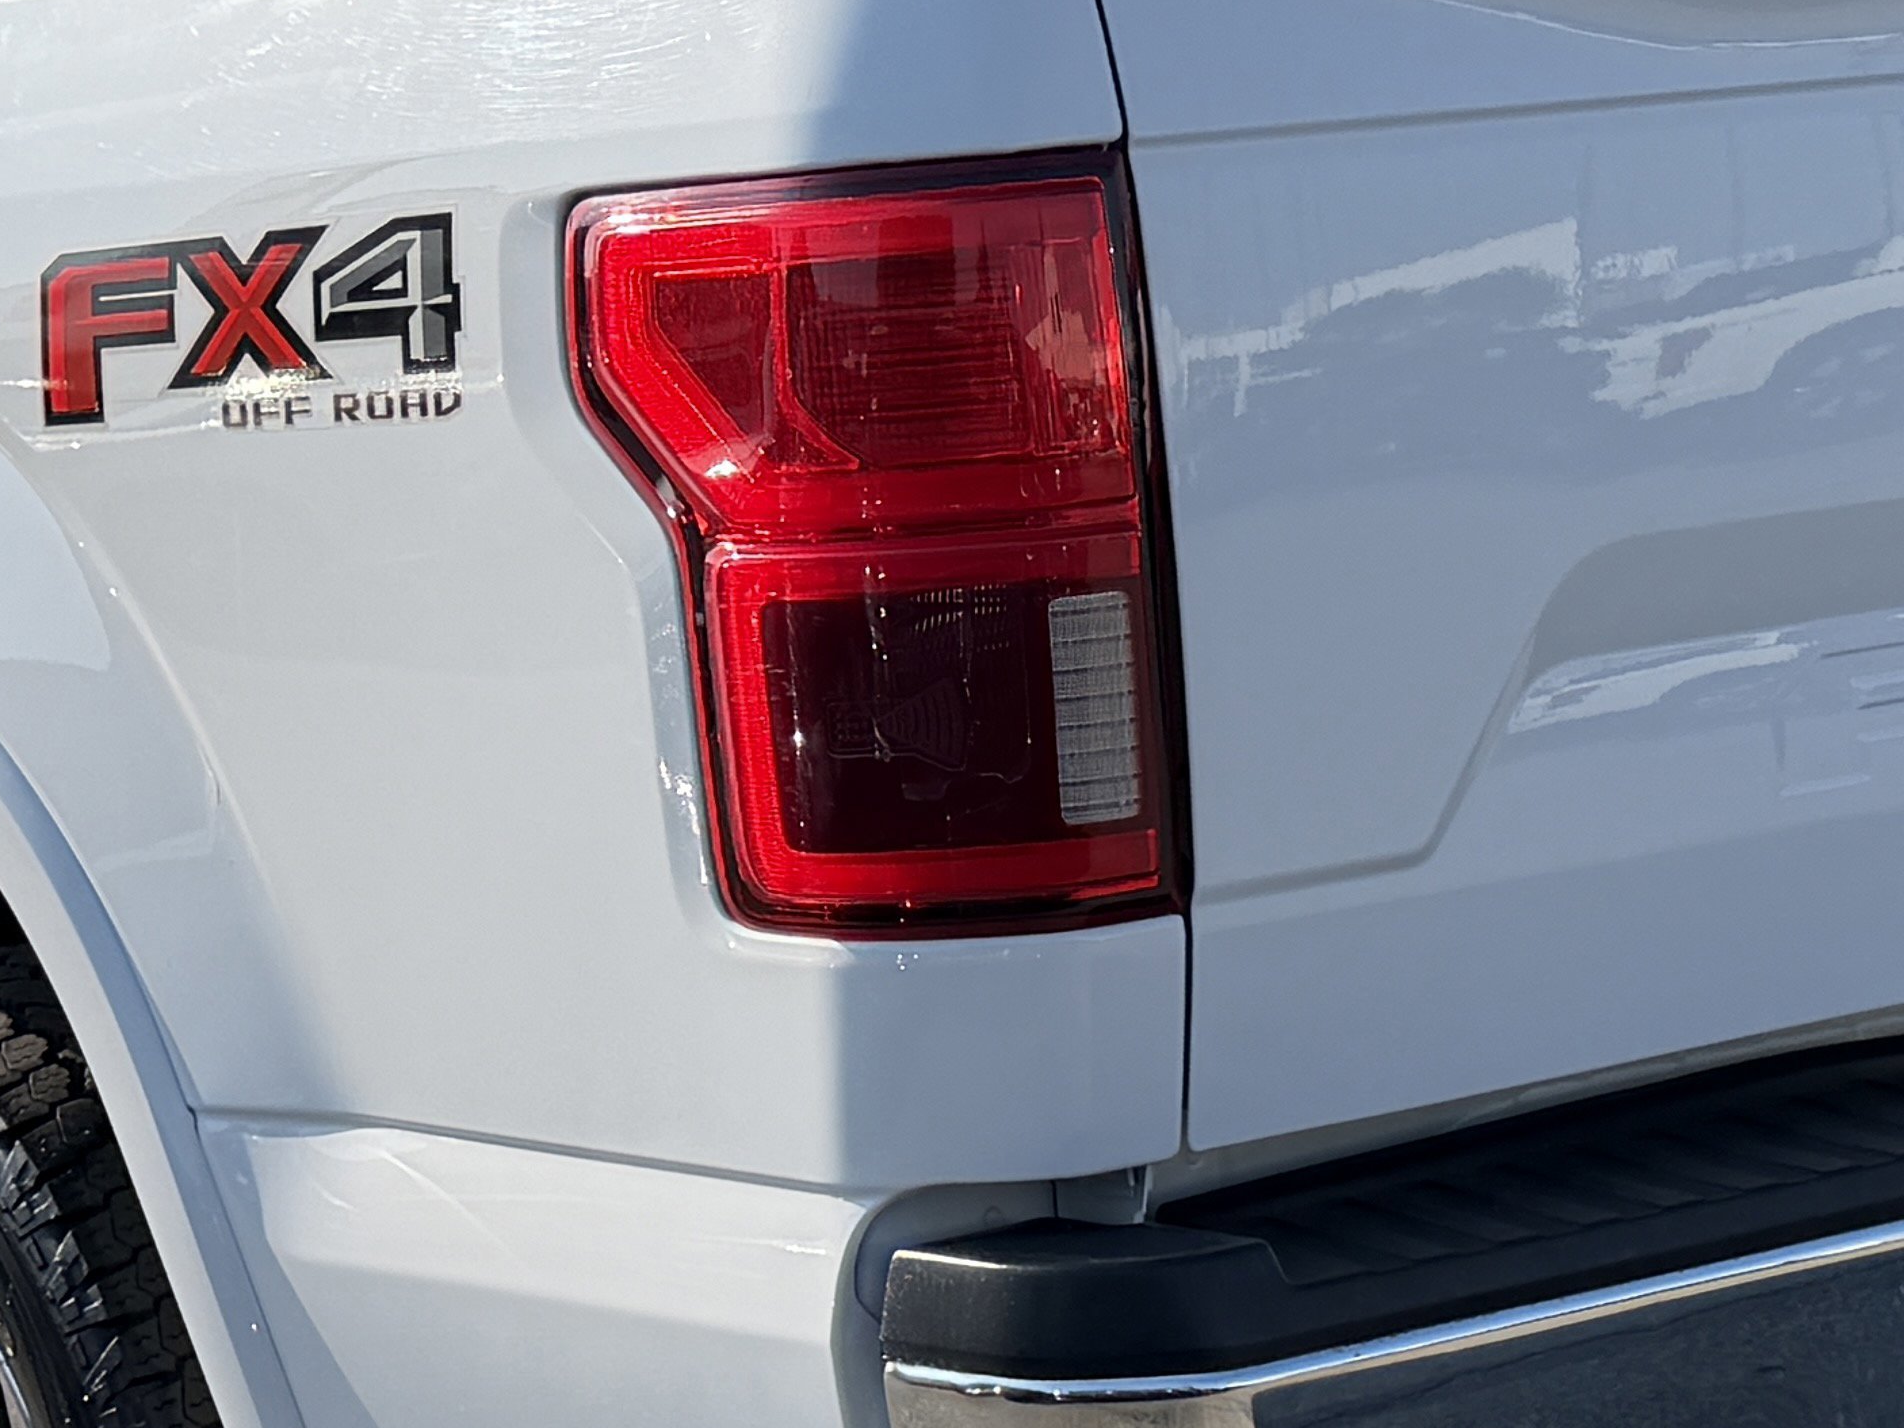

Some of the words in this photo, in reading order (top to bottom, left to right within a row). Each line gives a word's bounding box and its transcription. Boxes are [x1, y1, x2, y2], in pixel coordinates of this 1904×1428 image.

[41, 213, 461, 426] FX4
[221, 395, 313, 429] OFF
[333, 390, 462, 423] ROAD
